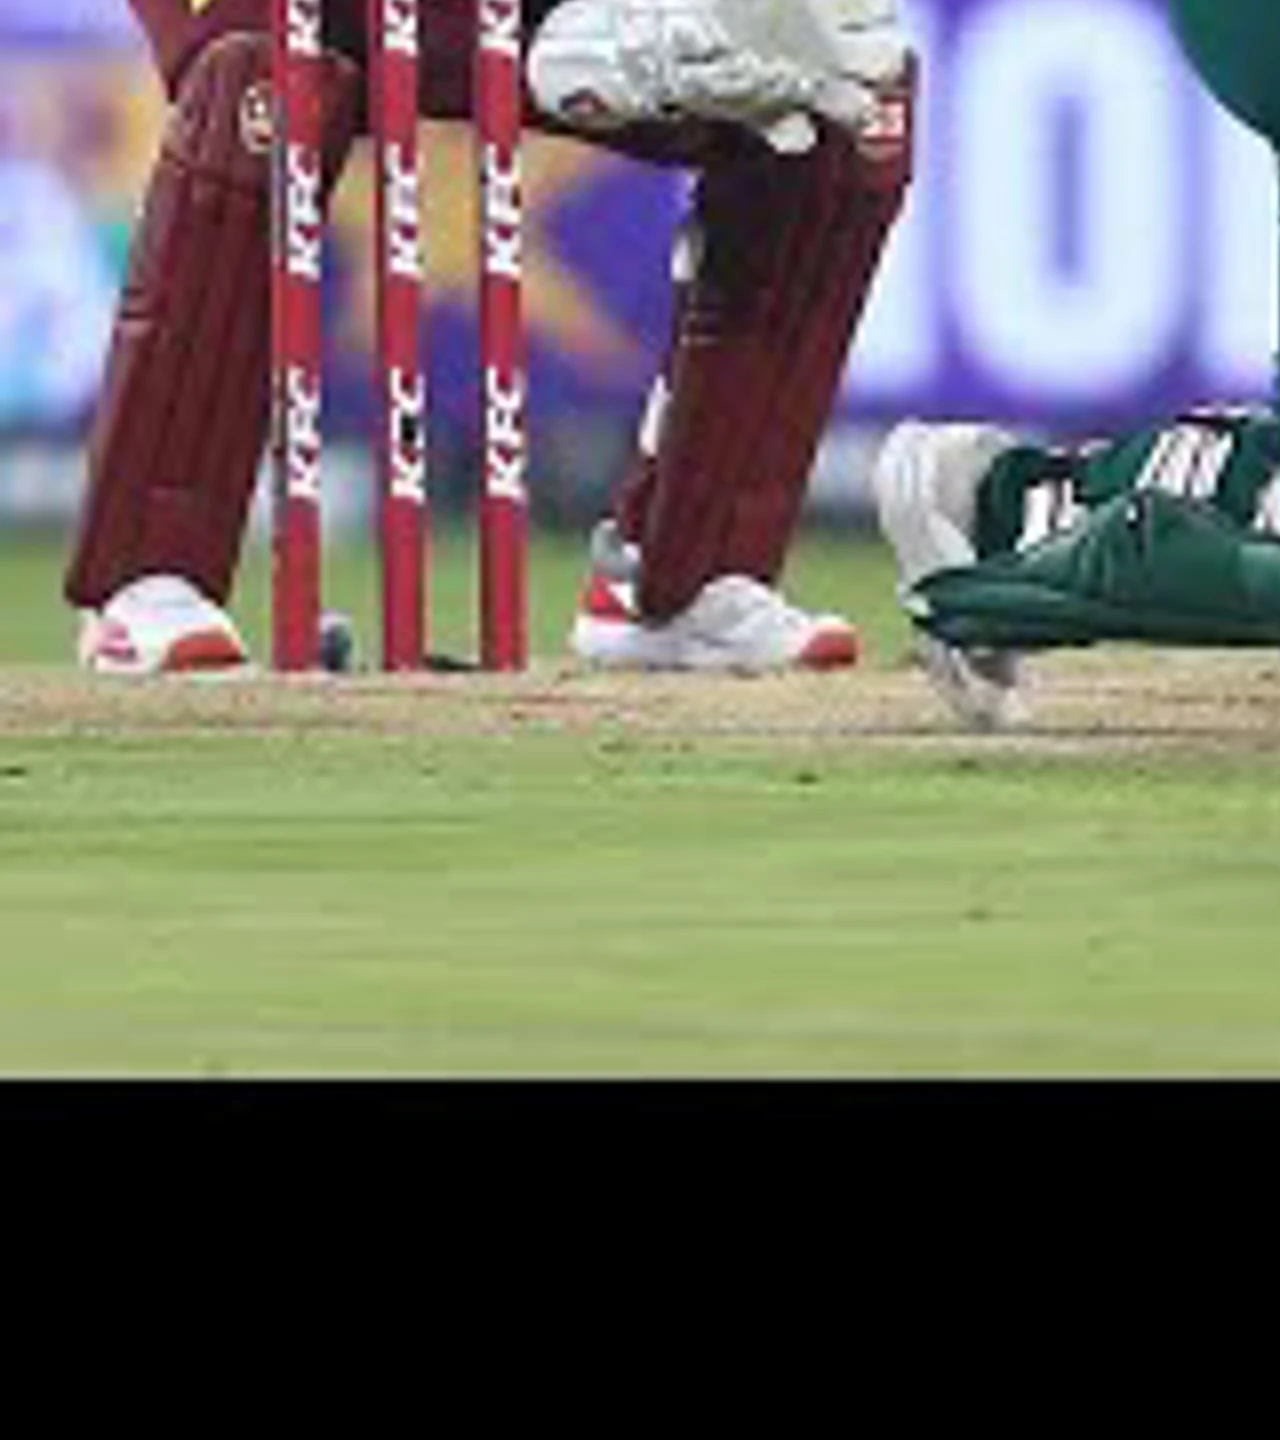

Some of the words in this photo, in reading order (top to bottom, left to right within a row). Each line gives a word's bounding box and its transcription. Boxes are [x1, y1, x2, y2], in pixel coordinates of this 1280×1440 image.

[287, 144, 321, 281] KFC
[386, 143, 424, 281] KFC
[486, 143, 522, 281] KFC
[287, 366, 321, 500] KFC
[486, 365, 526, 504] KFC
